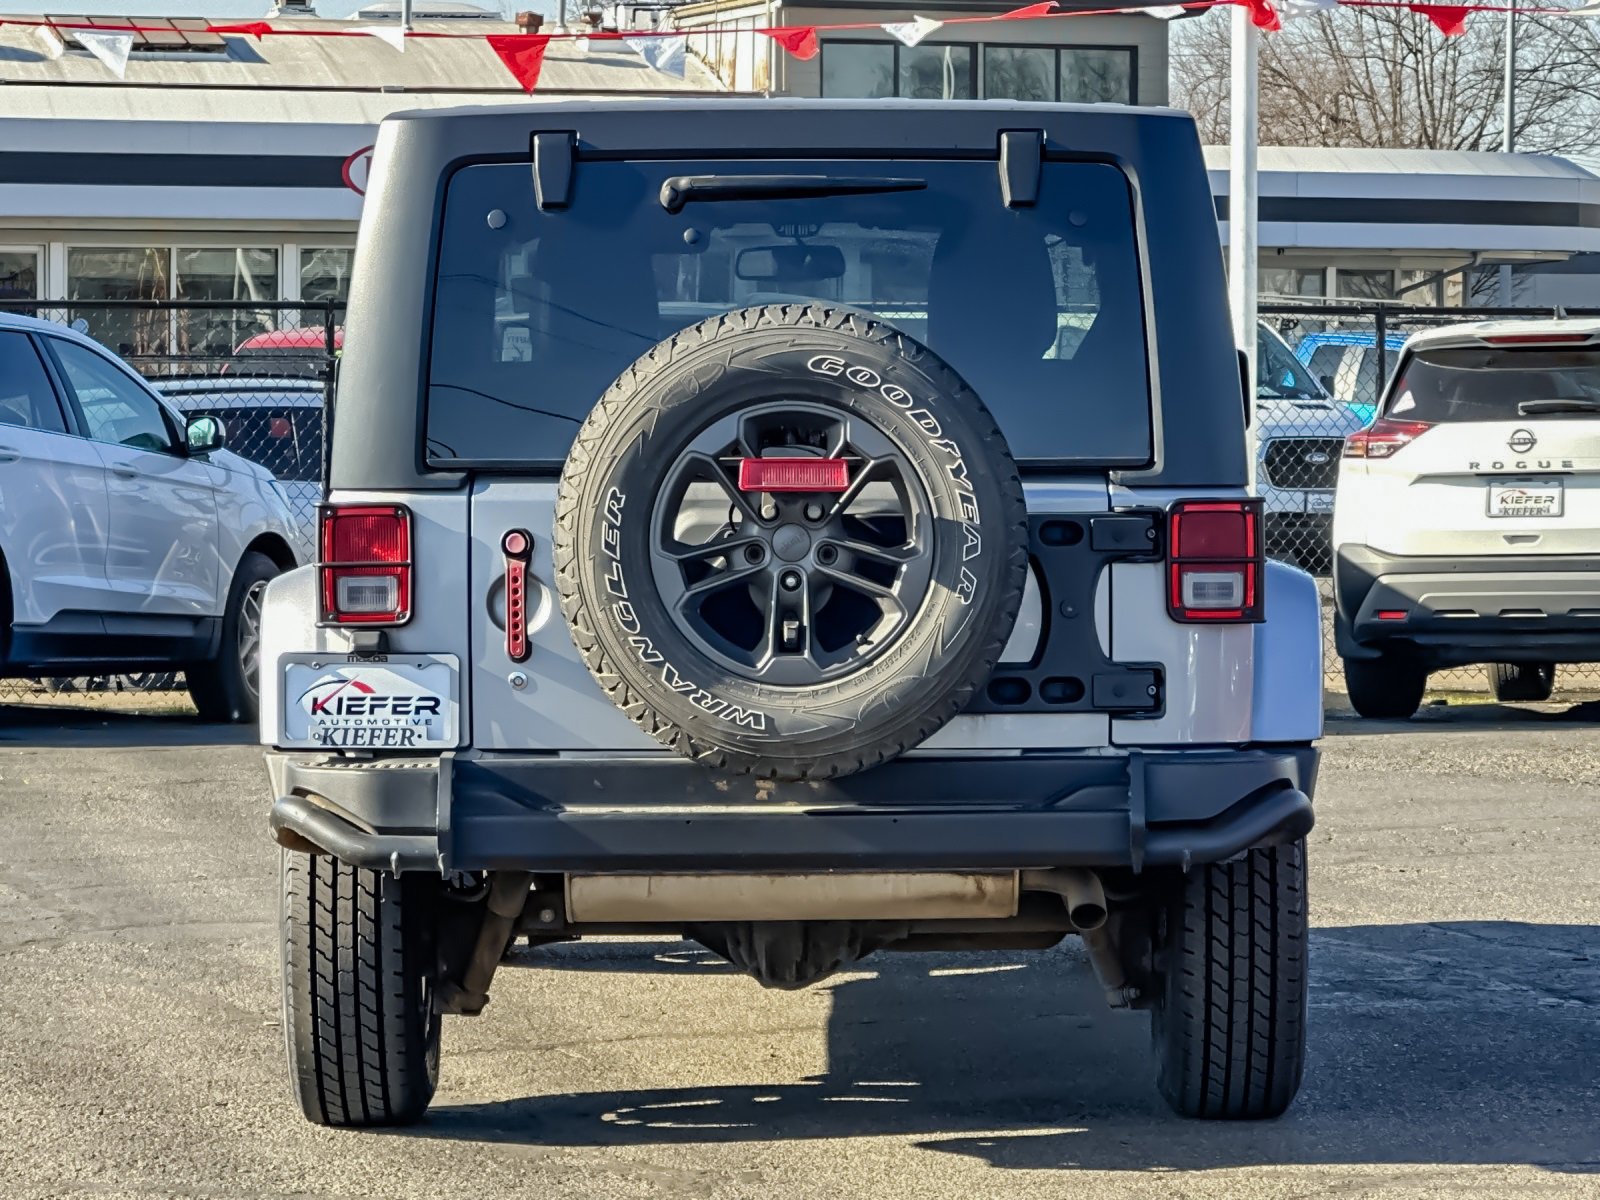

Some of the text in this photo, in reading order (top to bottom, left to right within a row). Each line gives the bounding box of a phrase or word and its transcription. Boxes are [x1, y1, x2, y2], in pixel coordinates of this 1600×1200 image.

[1468, 460, 1574, 470] ROGUE
[807, 355, 982, 605] GOODYEAR
[1500, 495, 1555, 505] KIEFER
[601, 486, 766, 730] WRANGLER
[311, 696, 441, 716] KIEFER
[318, 718, 433, 726] AUTOMOTIVE
[319, 727, 416, 747] KIEFER
